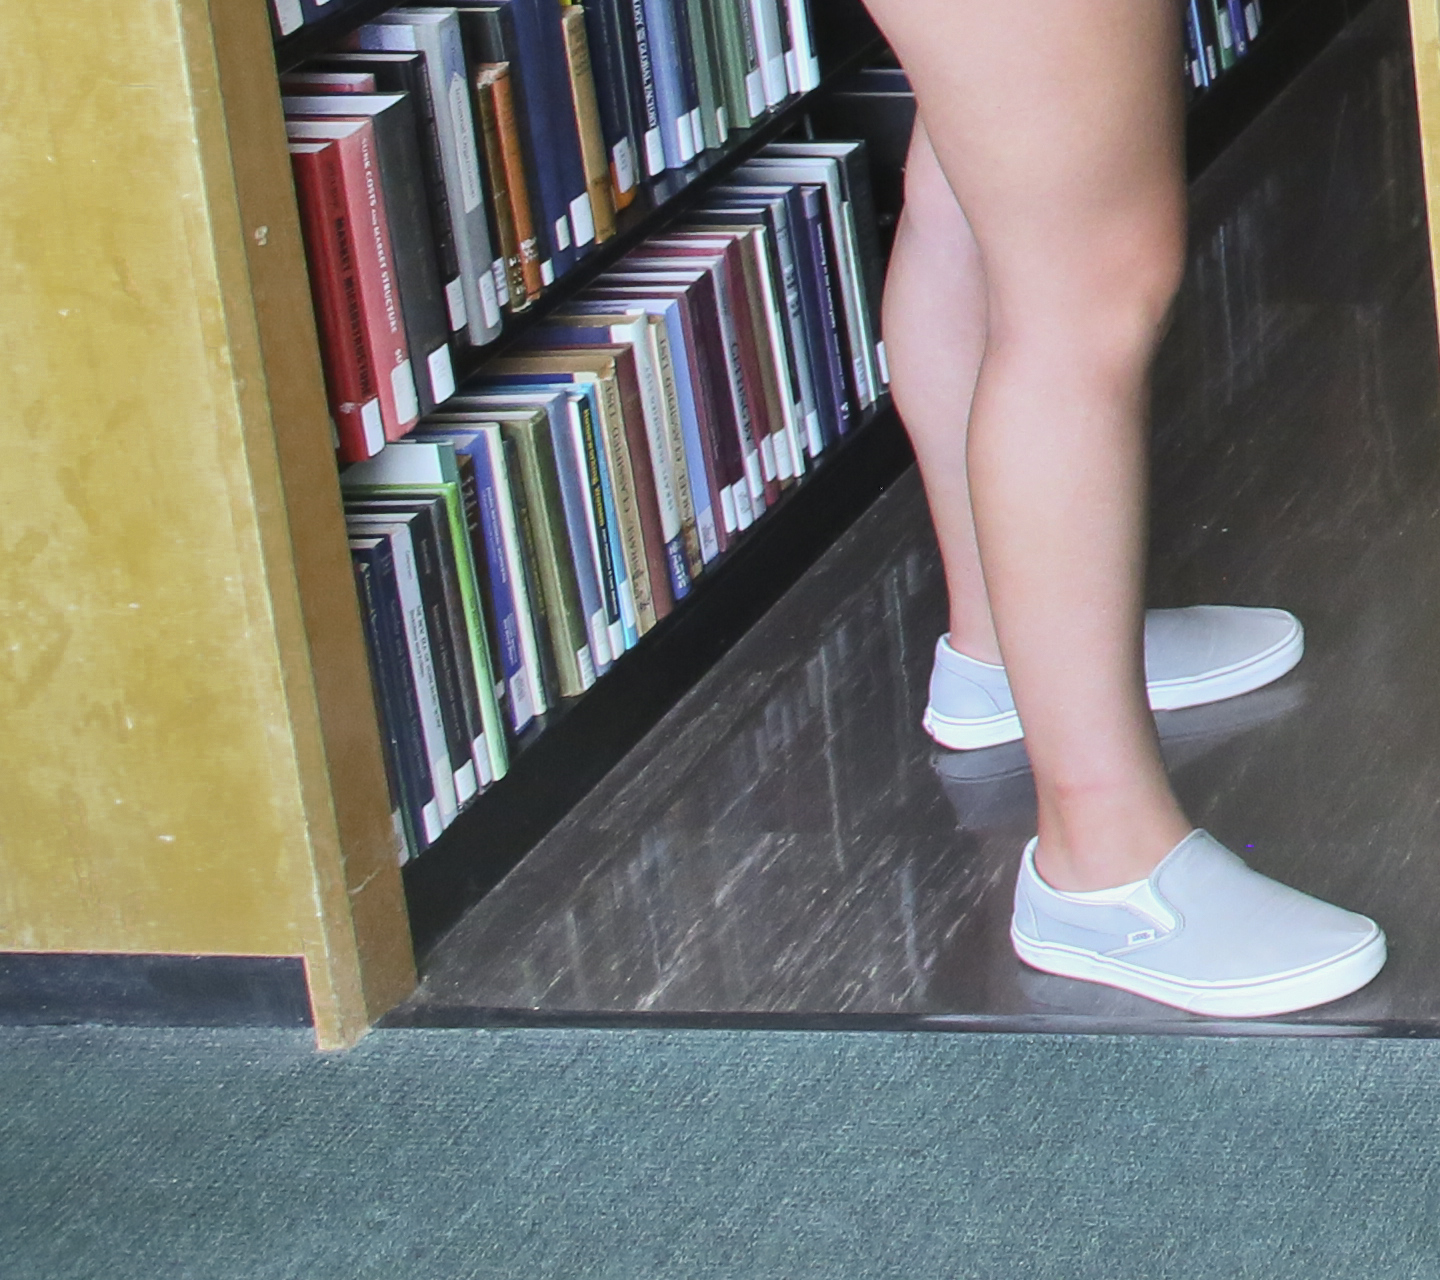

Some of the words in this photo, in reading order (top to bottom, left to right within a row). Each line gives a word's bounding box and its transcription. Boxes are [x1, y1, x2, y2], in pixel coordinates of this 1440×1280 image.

[638, 42, 652, 83] GLOBAL
[643, 85, 658, 128] FACTORY
[361, 137, 372, 168] SUNK
[365, 171, 377, 206] COSTS
[373, 226, 389, 269] MARKET
[381, 271, 399, 333] STRUCTURE
[732, 342, 751, 418] GETTING
